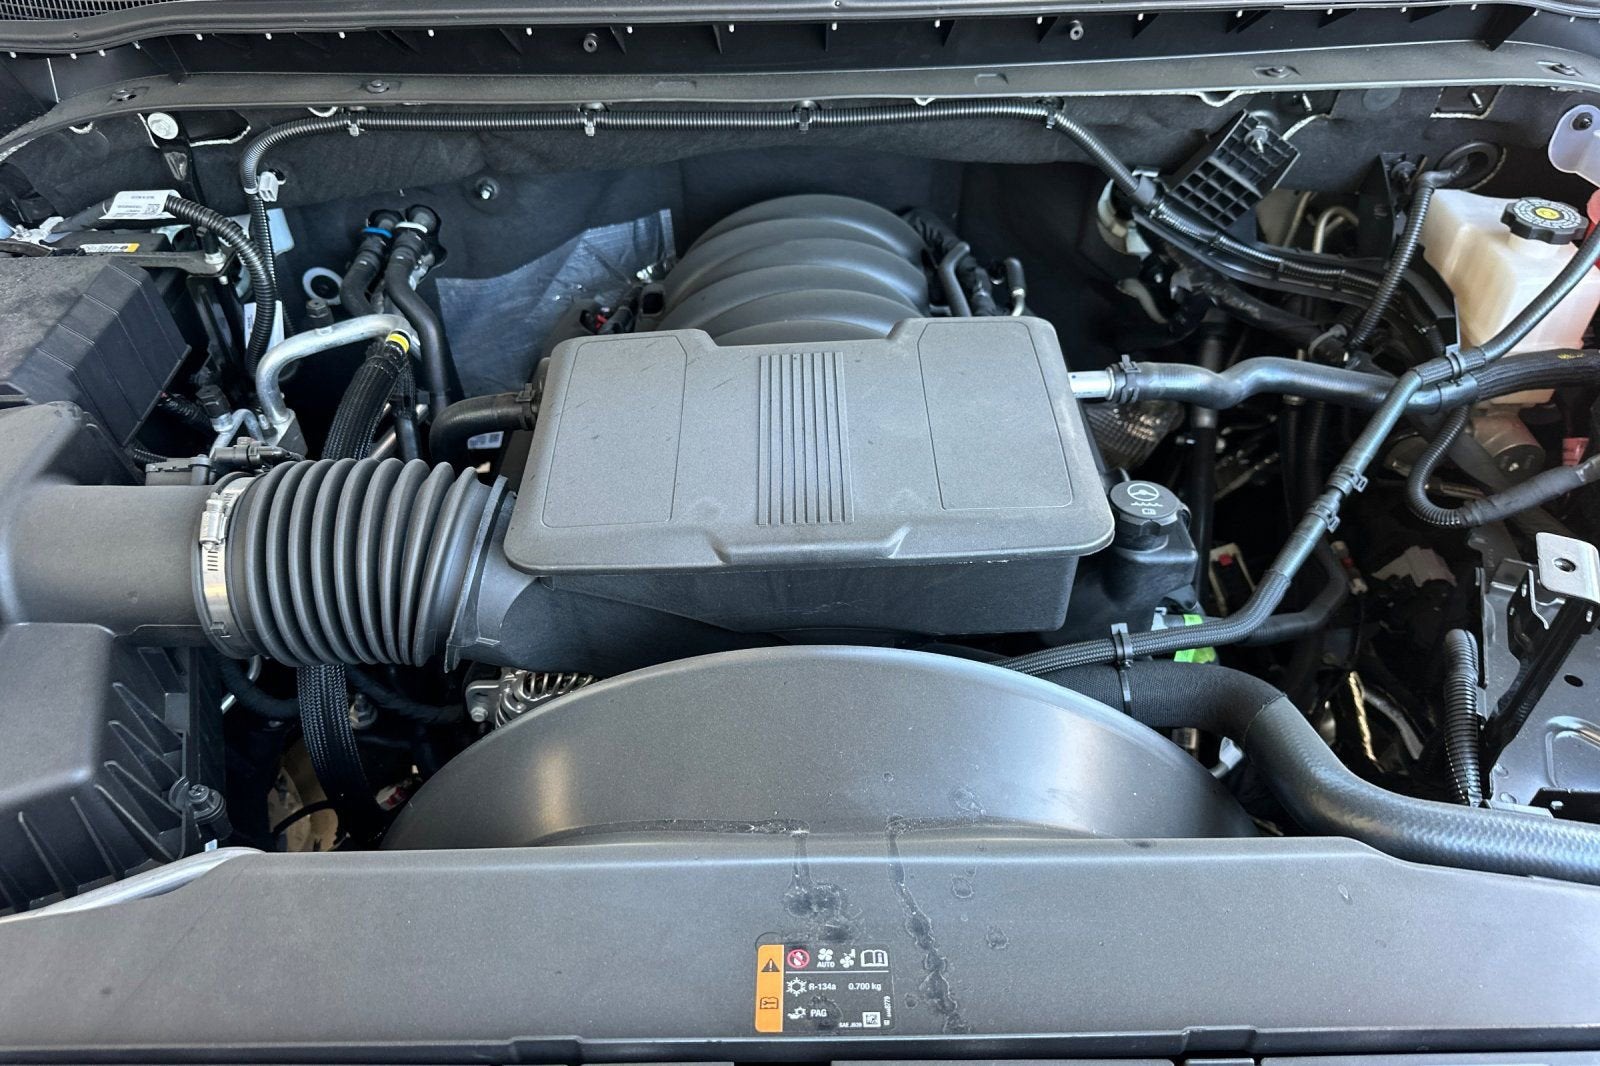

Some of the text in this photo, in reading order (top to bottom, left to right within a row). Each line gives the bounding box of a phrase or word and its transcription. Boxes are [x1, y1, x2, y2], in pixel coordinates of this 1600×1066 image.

[808, 982, 836, 990] R-134a
[848, 982, 882, 991] 0.700 kg
[810, 1009, 827, 1017] PAG
